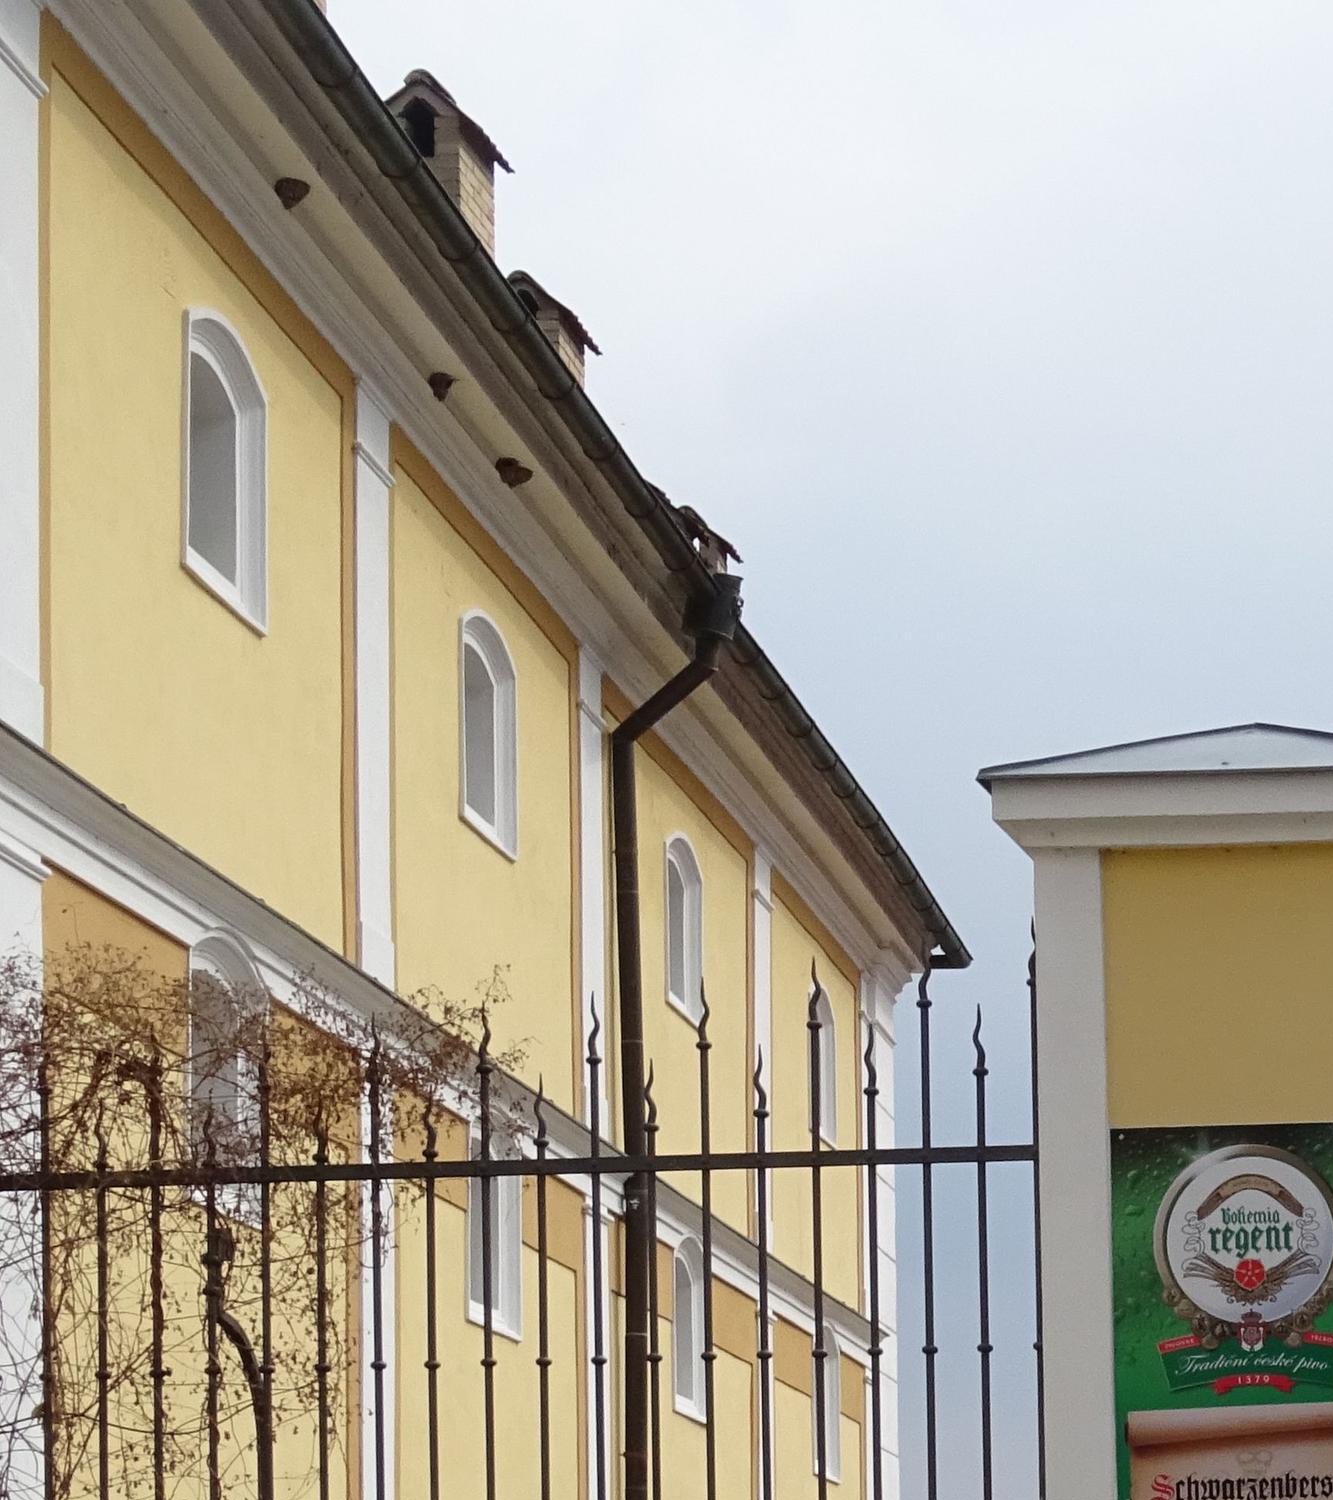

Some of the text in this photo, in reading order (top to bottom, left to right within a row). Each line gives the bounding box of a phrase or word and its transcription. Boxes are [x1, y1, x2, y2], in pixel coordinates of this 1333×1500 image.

[1208, 1220, 1294, 1258] regent
[1292, 1356, 1329, 1373] pivo
[1237, 1375, 1270, 1384] 1379
